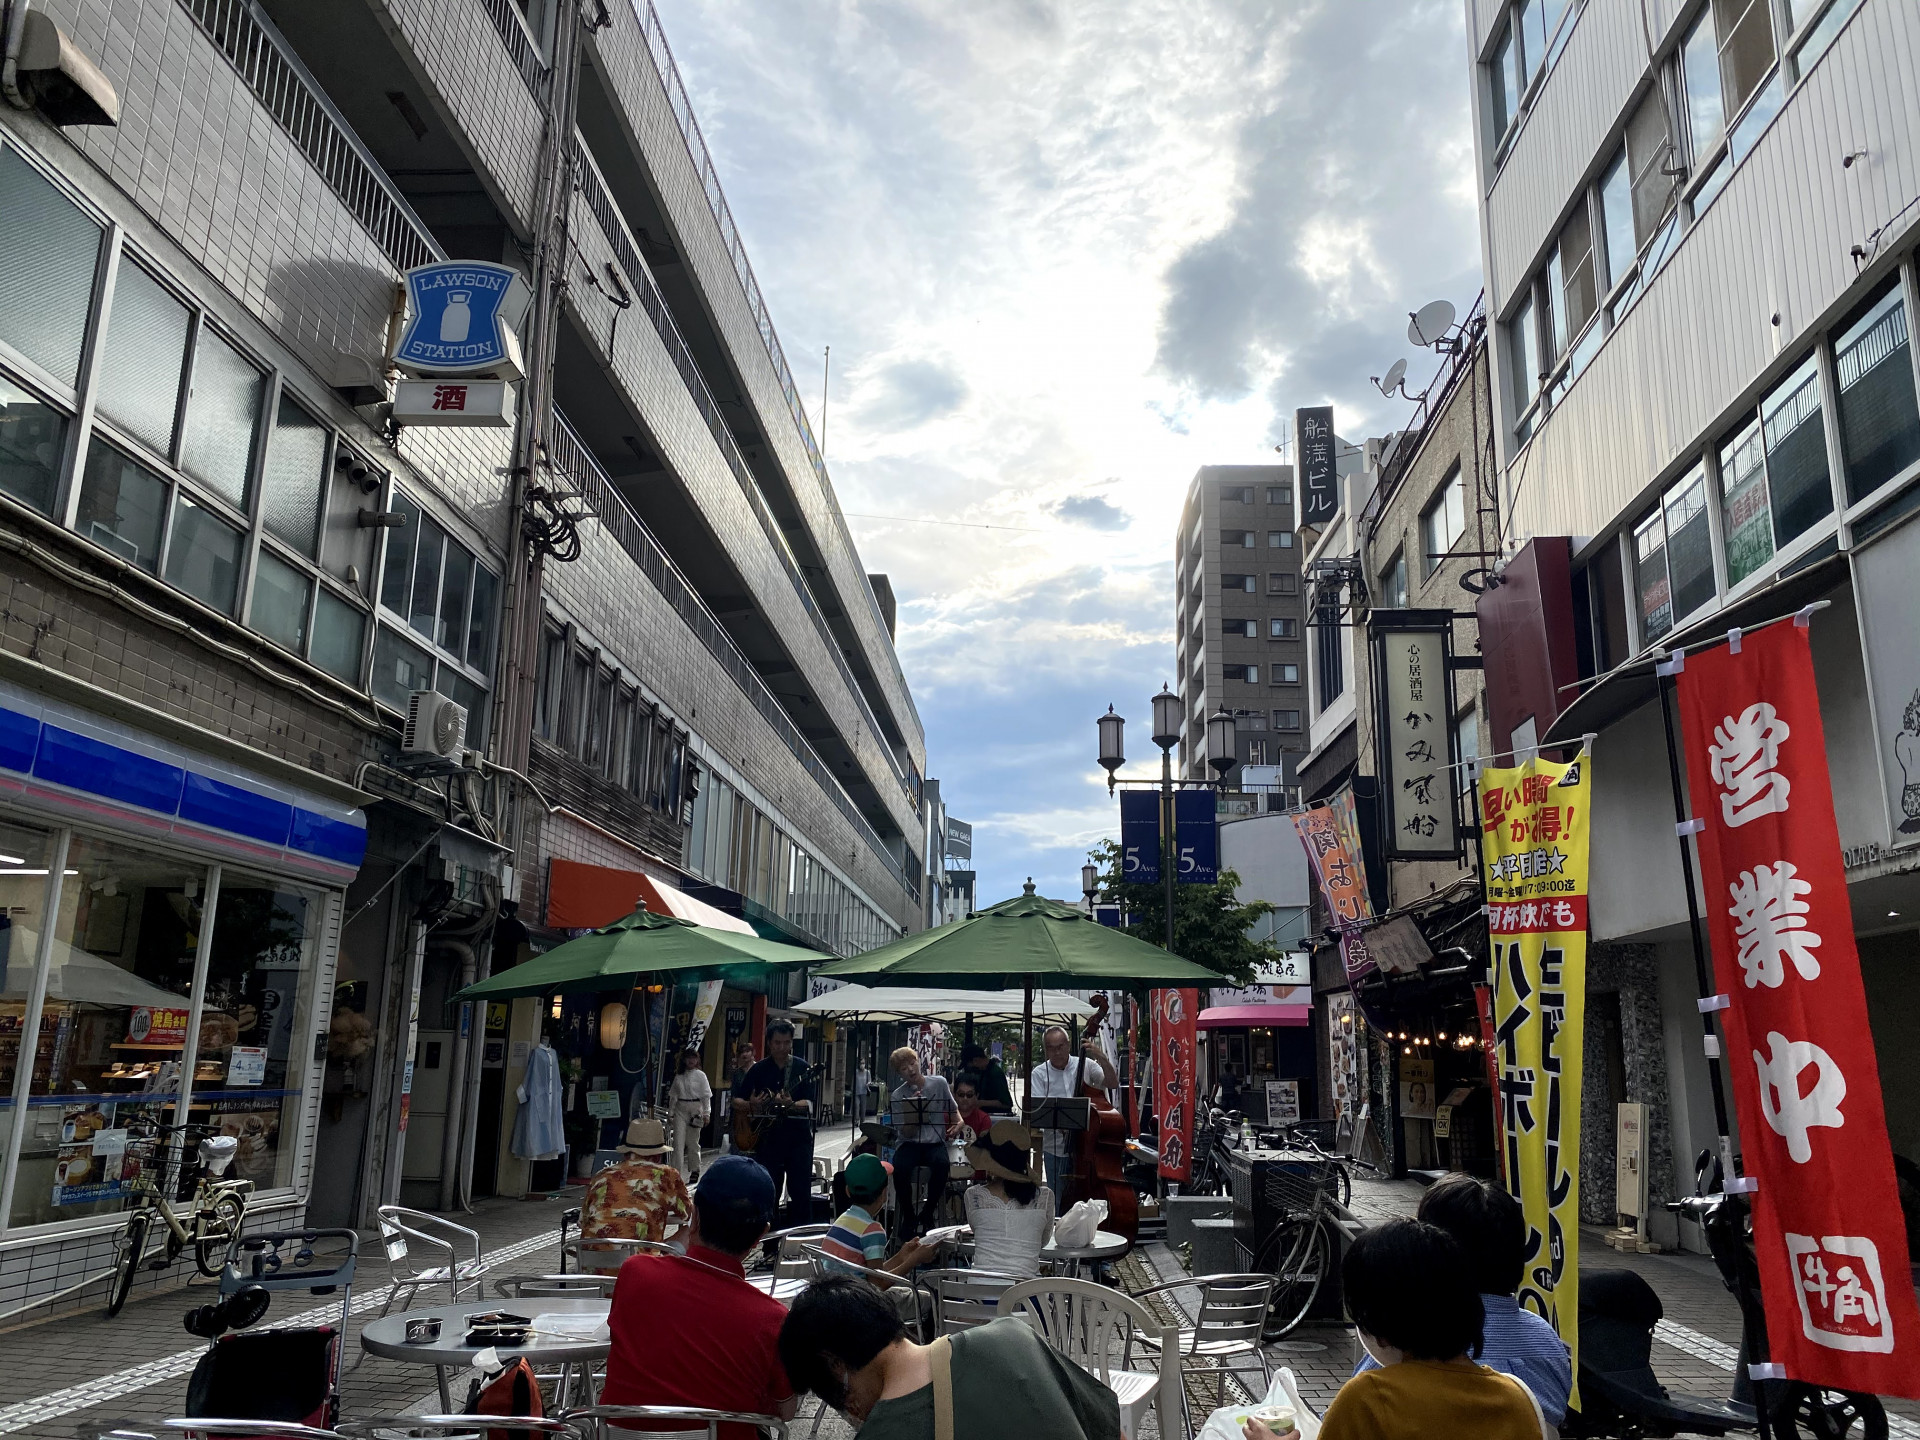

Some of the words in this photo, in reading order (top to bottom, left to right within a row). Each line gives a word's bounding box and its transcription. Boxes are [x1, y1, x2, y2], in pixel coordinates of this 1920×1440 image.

[419, 273, 503, 291] LAWSON
[411, 340, 493, 359] STATION
[432, 384, 467, 411] 酒
[1304, 417, 1332, 513] 船満ビル
[1407, 643, 1423, 702] 心の居酒屋
[949, 827, 960, 839] NEW
[1124, 845, 1141, 873] 5
[1139, 863, 1158, 872] Ave.
[1178, 846, 1196, 873] 5
[1194, 864, 1214, 873] Ave.
[1708, 701, 1847, 1164] 営業中
[727, 1010, 745, 1021] PUB
[1803, 1254, 1879, 1328] 牛角
